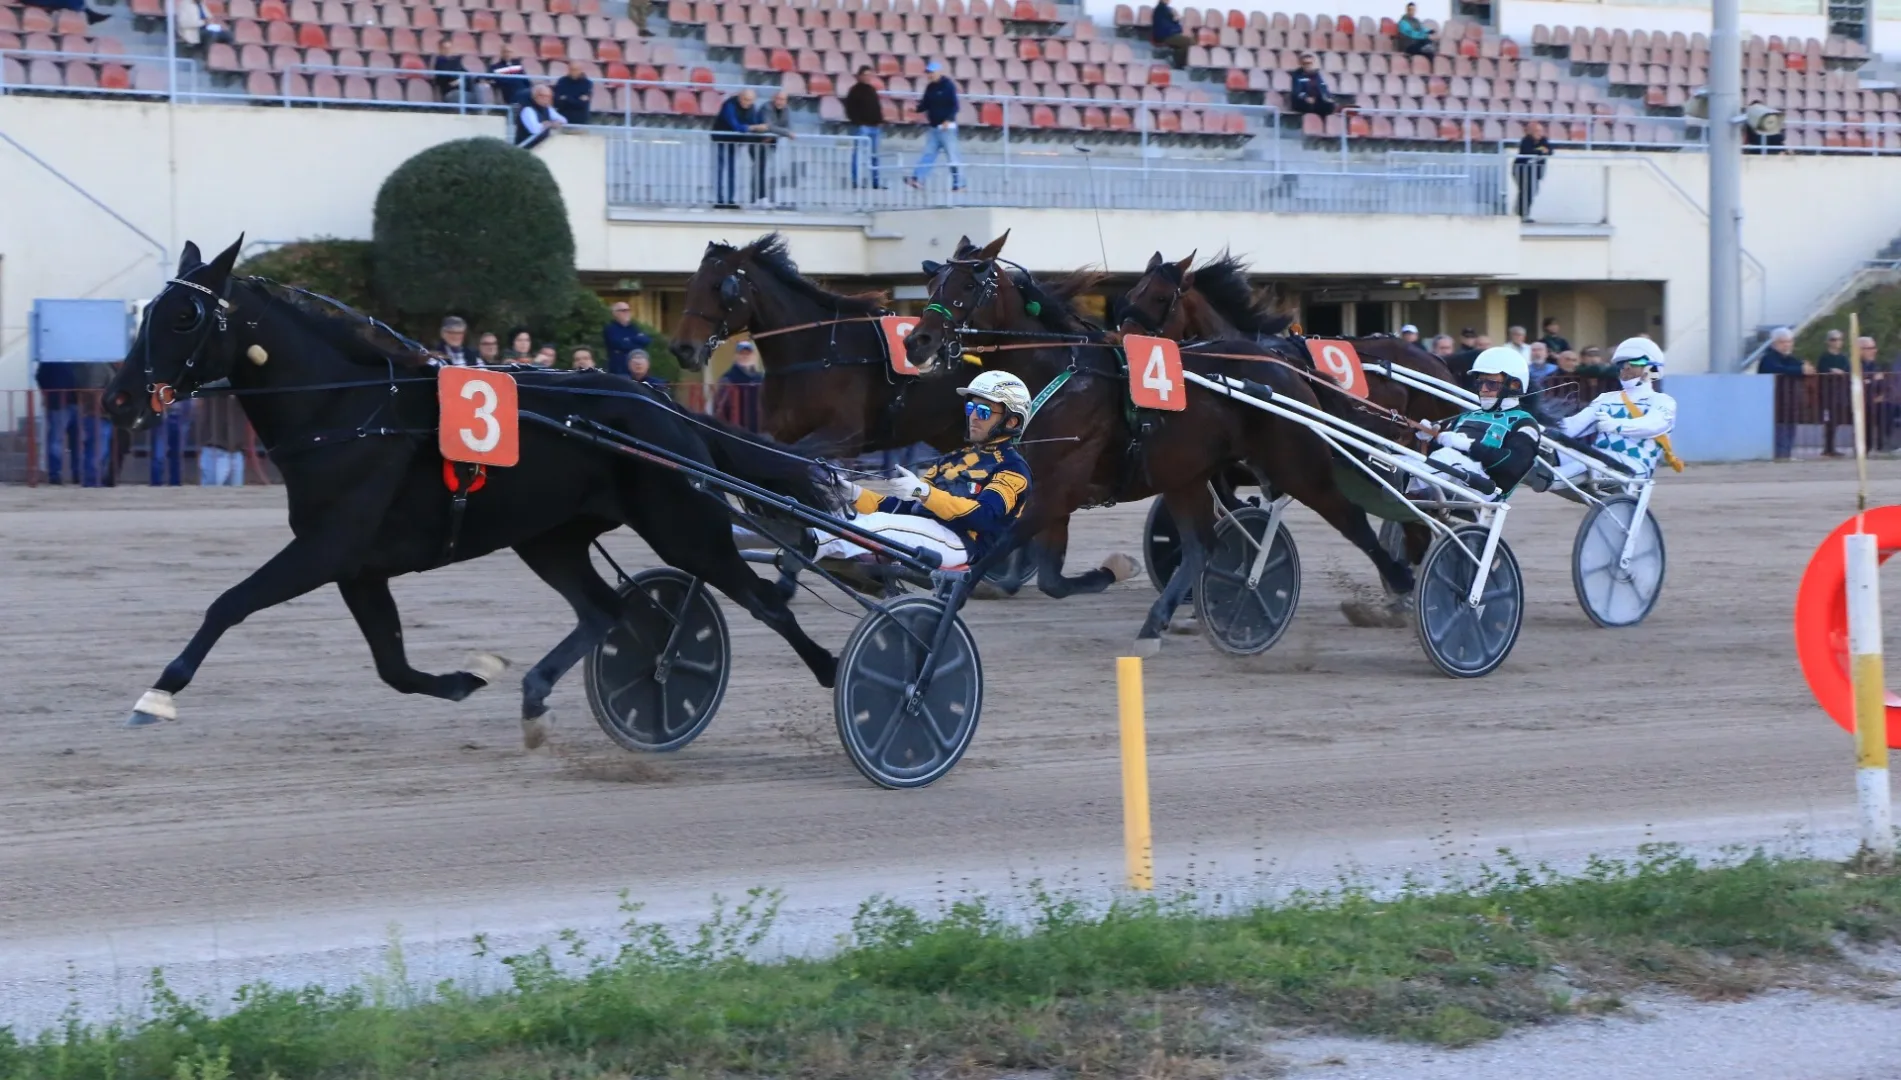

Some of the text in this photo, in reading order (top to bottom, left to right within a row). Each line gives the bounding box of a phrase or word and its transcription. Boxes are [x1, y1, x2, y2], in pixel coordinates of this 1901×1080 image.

[1142, 345, 1173, 401] 4
[1322, 345, 1354, 390] 9
[459, 379, 501, 452] 3
